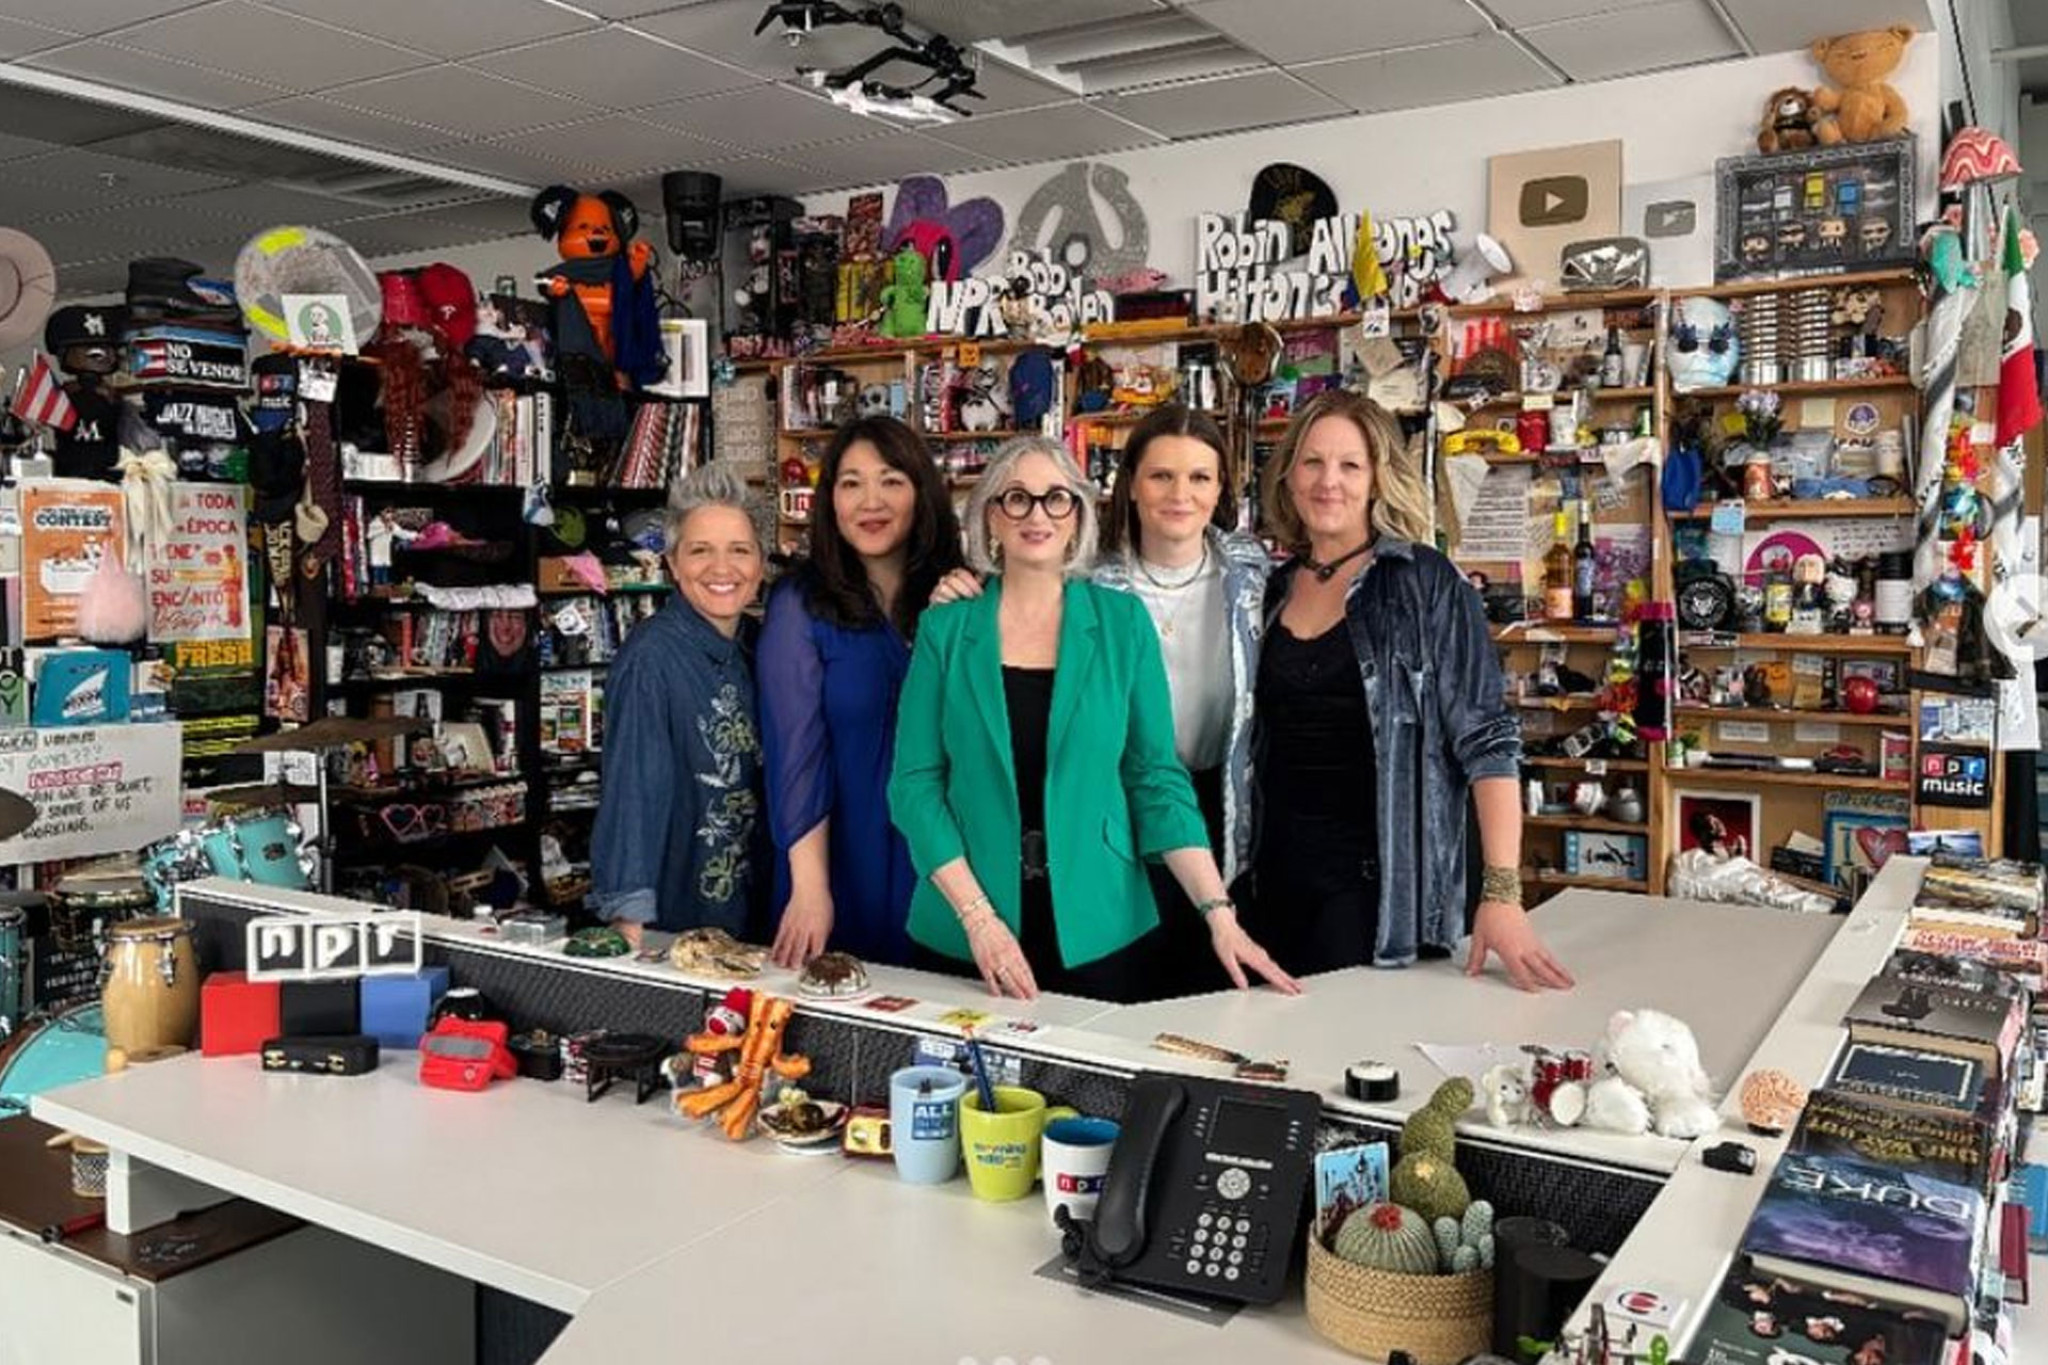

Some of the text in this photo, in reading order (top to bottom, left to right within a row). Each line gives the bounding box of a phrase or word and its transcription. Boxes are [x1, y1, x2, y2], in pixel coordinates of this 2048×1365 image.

[1199, 212, 1288, 271] Robin
[1009, 247, 1066, 296] Bob
[926, 276, 1010, 338] NPR
[166, 342, 191, 359] NO
[166, 358, 188, 374] SE
[197, 493, 236, 510] TODA
[187, 516, 237, 534] ÉPOCA
[1922, 779, 1984, 796] music
[257, 920, 405, 971] npr
[1783, 1165, 1972, 1220] DUKE
